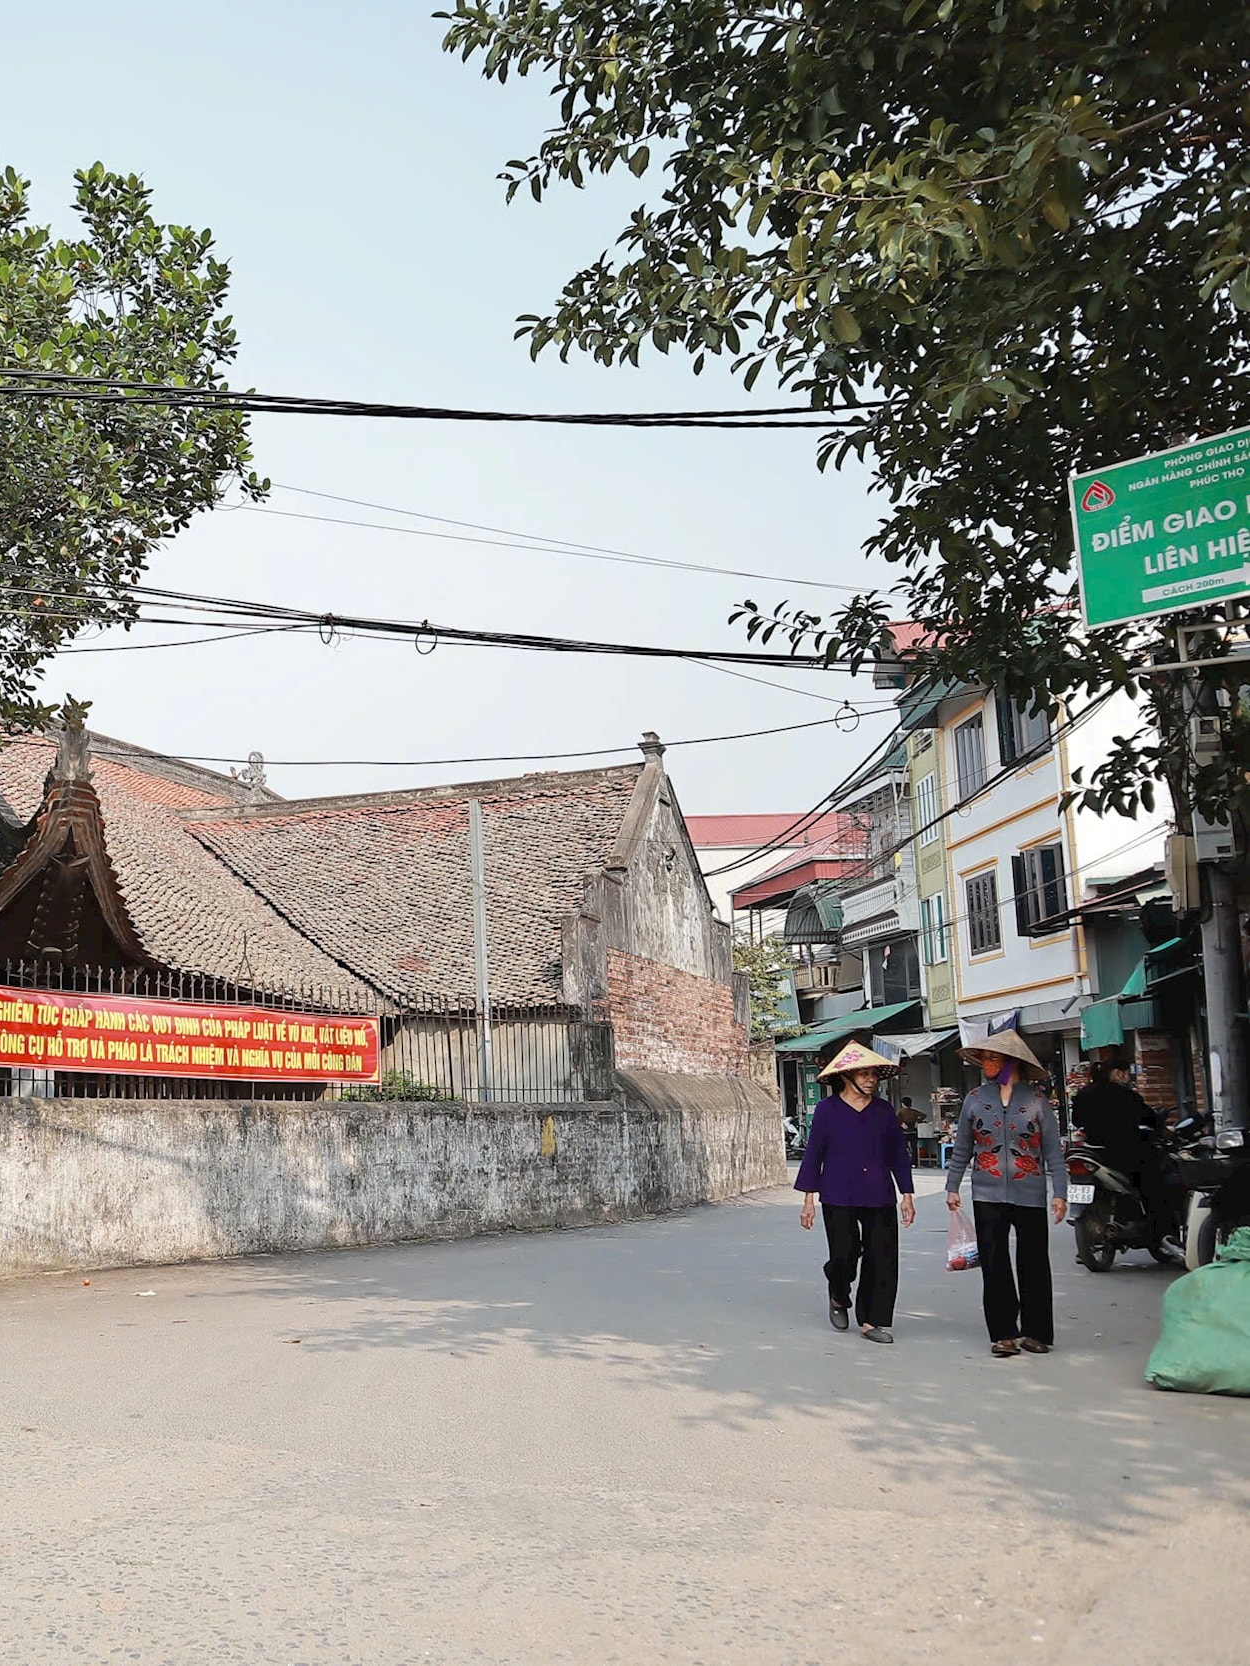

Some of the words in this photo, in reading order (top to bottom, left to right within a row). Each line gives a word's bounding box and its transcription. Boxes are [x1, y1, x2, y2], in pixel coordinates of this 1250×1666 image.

[1164, 450, 1203, 468] PHÒNG
[1206, 443, 1234, 456] GIAO
[1237, 438, 1250, 448] DỊ
[1128, 476, 1159, 492] NGÂN
[1162, 467, 1193, 483] HÀNG
[1196, 457, 1231, 472] CHÍNH
[1190, 474, 1219, 488] PHÚC
[1222, 467, 1245, 480] THỌ
[1092, 515, 1155, 552] ĐIỂM
[1163, 500, 1237, 533] GIAO
[1144, 545, 1198, 575] LIÊN
[1162, 582, 1193, 597] CÁCH
[1196, 577, 1225, 588] 200m
[38, 1002, 60, 1026] TÚC
[62, 1002, 92, 1028] CHẤP
[95, 1007, 126, 1031] HÀNH
[128, 1010, 150, 1034] CÁC
[152, 1015, 172, 1034] QUY
[174, 1016, 200, 1039] ĐỊNH
[202, 1013, 222, 1038] CỦA
[225, 1017, 250, 1040] PHÁP
[252, 1020, 274, 1044] LUẬT
[288, 1022, 299, 1042] VŨ
[319, 1024, 334, 1048] VẬT
[336, 1025, 353, 1048] LIỆU
[28, 1035, 44, 1060] CỤ
[48, 1030, 64, 1057] HỖ
[66, 1037, 88, 1062] TRỢ
[91, 1036, 106, 1060] VÀ
[108, 1038, 137, 1062] PHÁO
[140, 1040, 154, 1062] LÀ
[156, 1040, 190, 1064] TRÁCH
[192, 1043, 224, 1069] NHIỆM
[227, 1044, 240, 1067] VÀ
[242, 1046, 270, 1069] NGHĨA
[272, 1051, 283, 1072] VỤ
[285, 1046, 302, 1070] CỦA
[322, 1049, 344, 1072] CÔNG
[346, 1050, 362, 1072] DÂN
